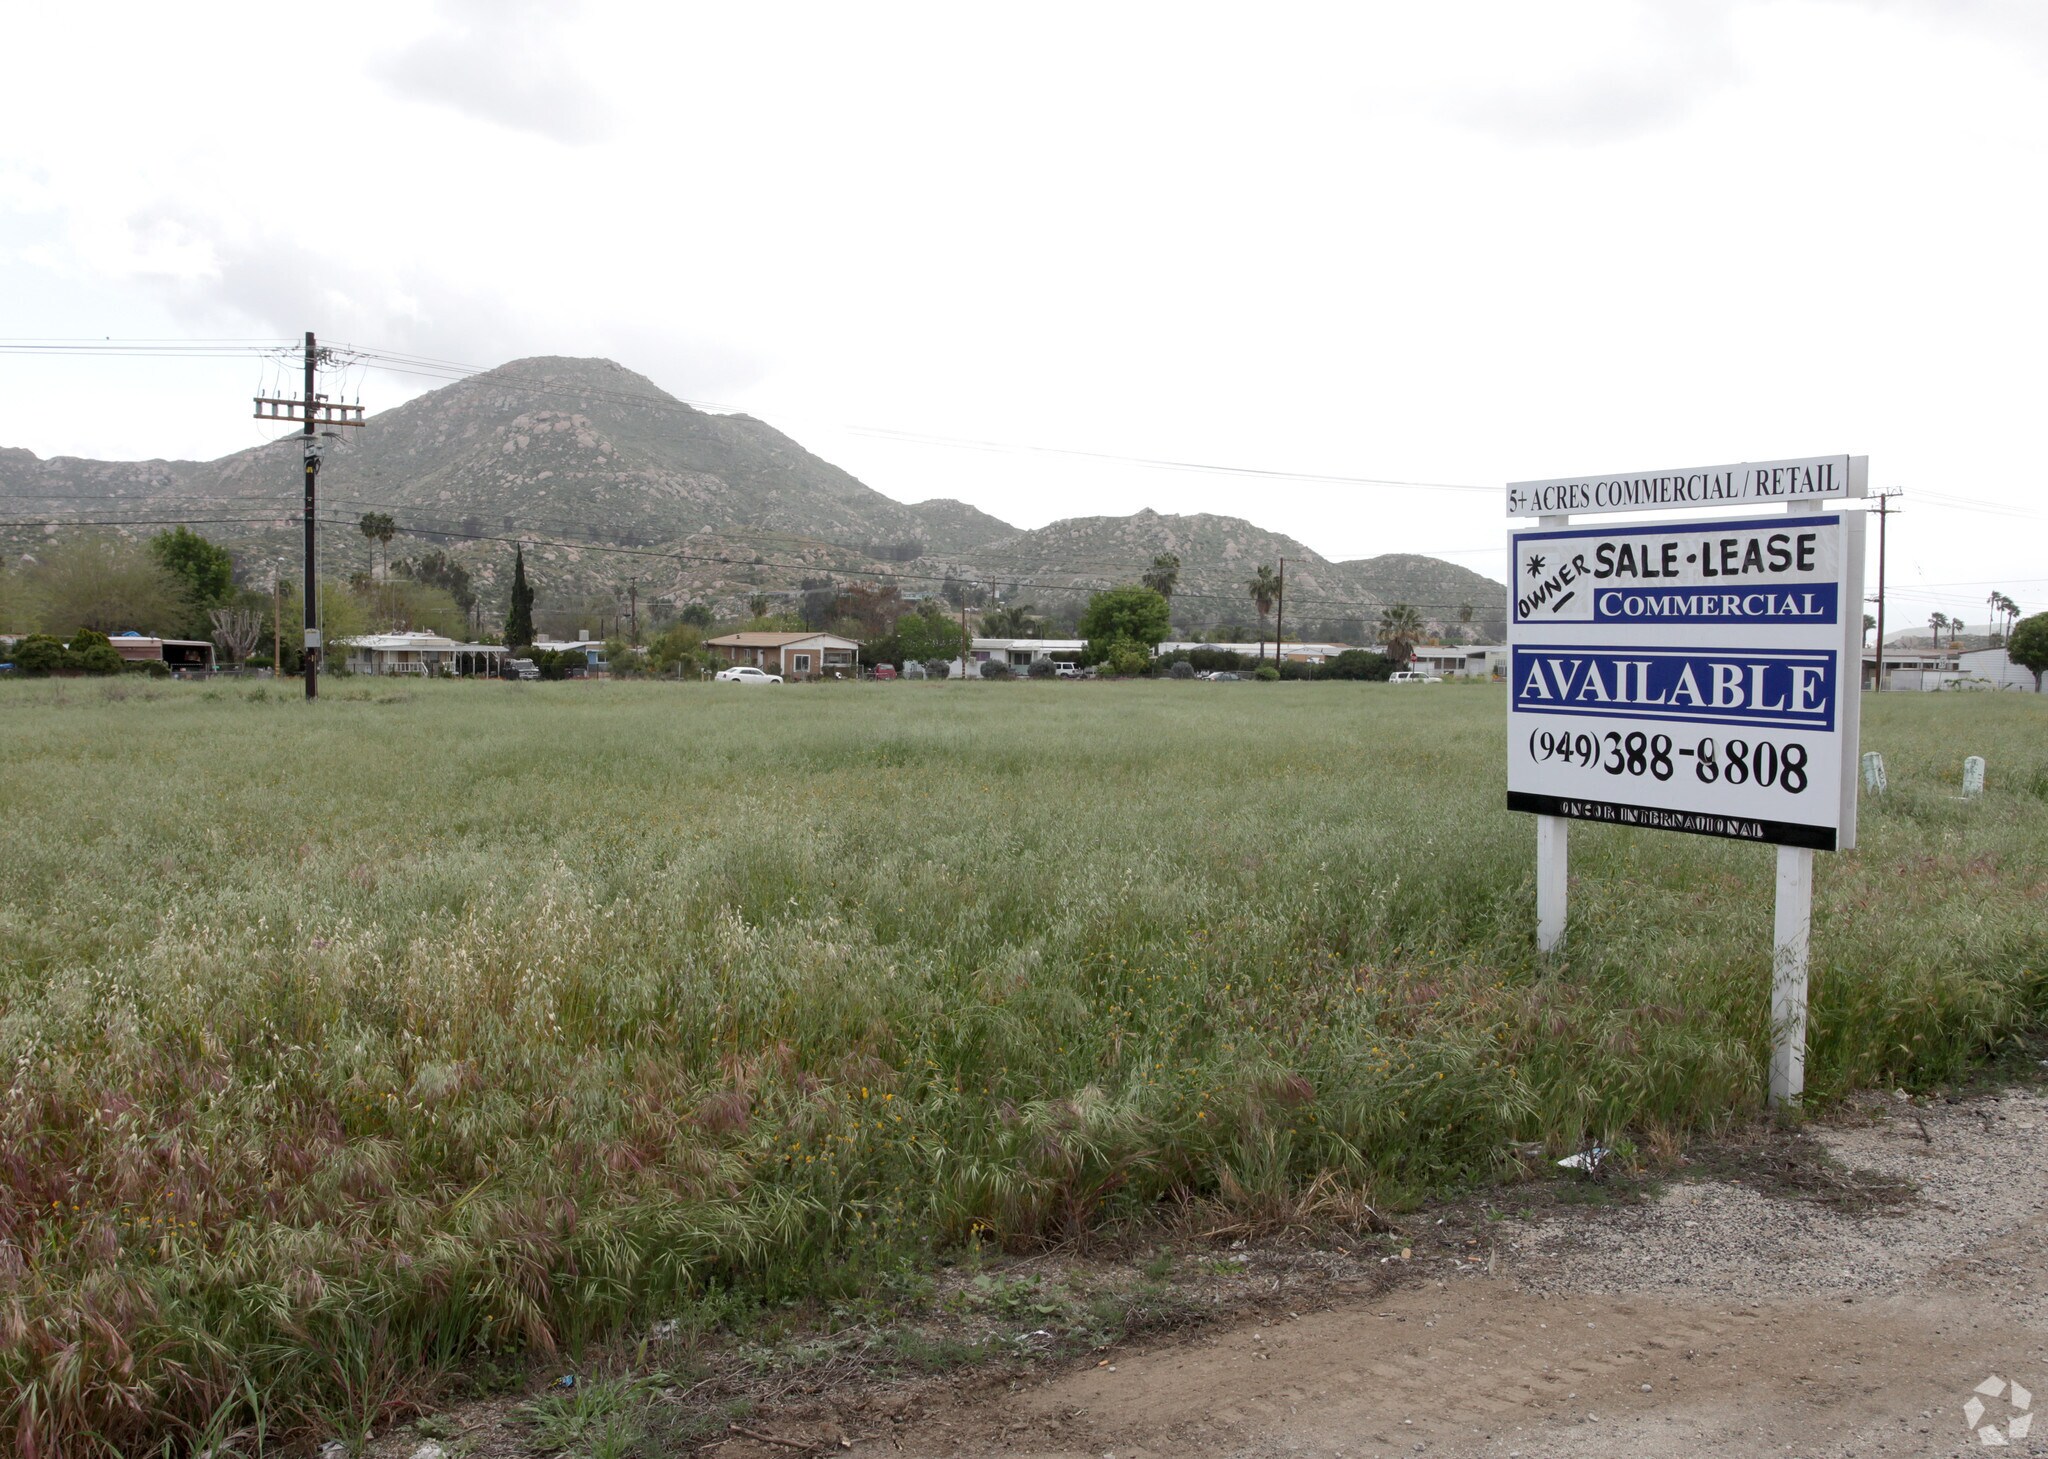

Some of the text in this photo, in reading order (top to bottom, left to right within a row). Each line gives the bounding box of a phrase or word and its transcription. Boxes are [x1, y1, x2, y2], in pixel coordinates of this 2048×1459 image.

[1509, 489, 1527, 512] 5+
[1531, 484, 1590, 510] ACRES
[1595, 472, 1739, 507] COMMERCIAL
[1755, 463, 1840, 495] RETAIL
[1518, 553, 1591, 619] OWNER
[1599, 591, 1823, 617] COMMERCIAL
[1519, 658, 1829, 713] AVAILABLE
